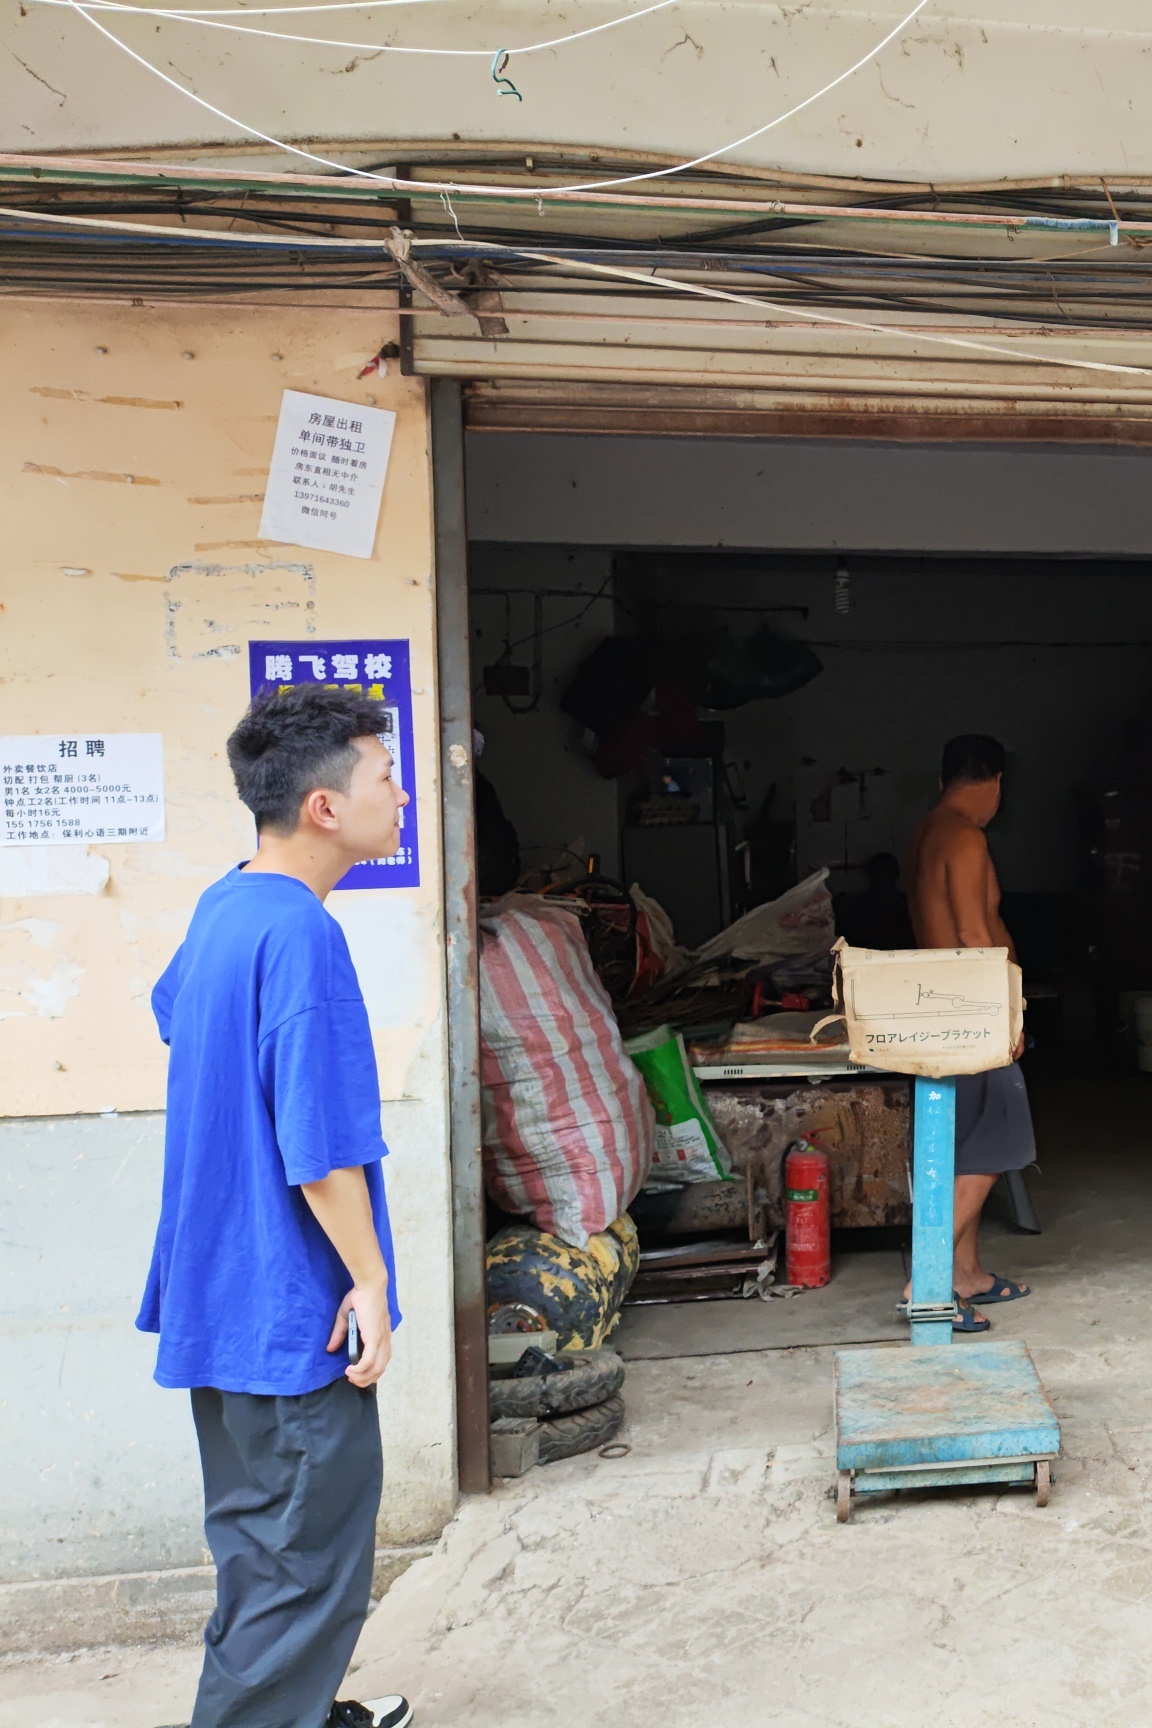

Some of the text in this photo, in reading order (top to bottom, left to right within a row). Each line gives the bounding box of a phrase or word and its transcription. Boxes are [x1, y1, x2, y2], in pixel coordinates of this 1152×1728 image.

[308, 412, 362, 434] 房屋出租
[298, 429, 366, 454] 单间带独卫
[291, 446, 367, 470] 价格面议 随时看房
[295, 462, 358, 482] 房东直租无中介
[294, 490, 350, 508] 13971643360
[301, 505, 337, 520] 微信同号
[265, 653, 392, 681] 腾飞驾校
[58, 739, 106, 758] 招聘
[3, 764, 57, 774] 外卖餐饮店
[3, 775, 25, 785] 切配
[28, 775, 49, 785] 打包
[53, 774, 74, 784] 帮厨
[4, 787, 30, 796] 男1名
[34, 785, 60, 795] 女2名
[5, 807, 61, 818] 每小时16元
[865, 1027, 991, 1045] フロアレイジーブラケット
